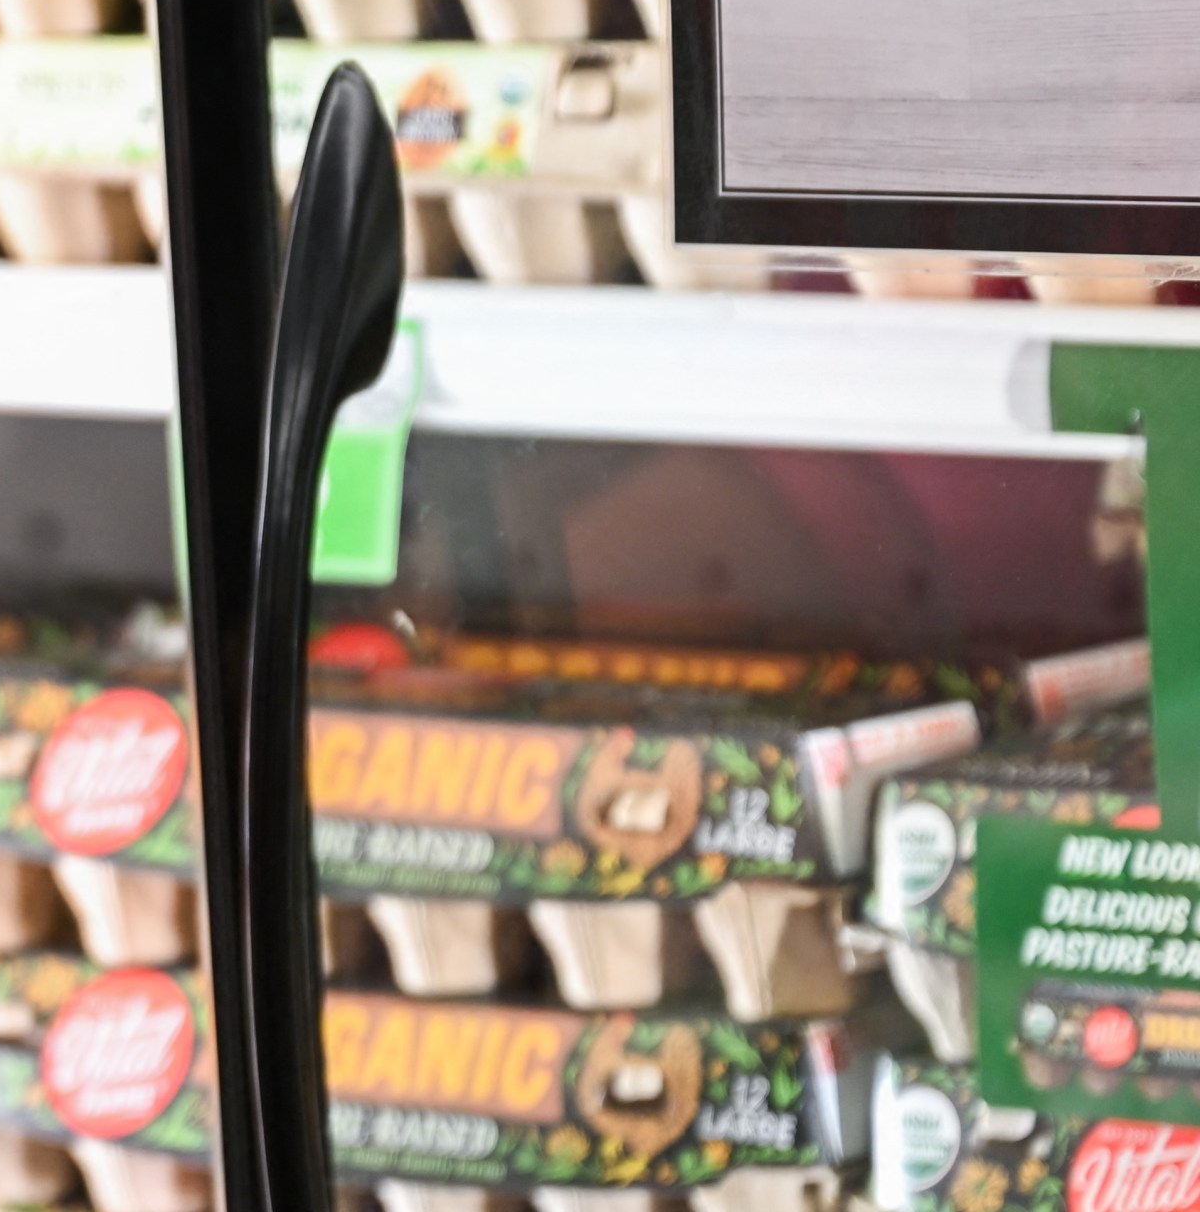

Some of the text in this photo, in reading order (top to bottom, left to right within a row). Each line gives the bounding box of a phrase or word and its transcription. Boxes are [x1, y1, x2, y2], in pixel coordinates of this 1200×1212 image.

[309, 723, 559, 824] GANIC
[1058, 834, 1132, 877] NEW
[1042, 884, 1191, 935] DELICIOUS
[321, 1002, 559, 1111] GANIC
[1070, 1124, 1200, 1212] Vital
